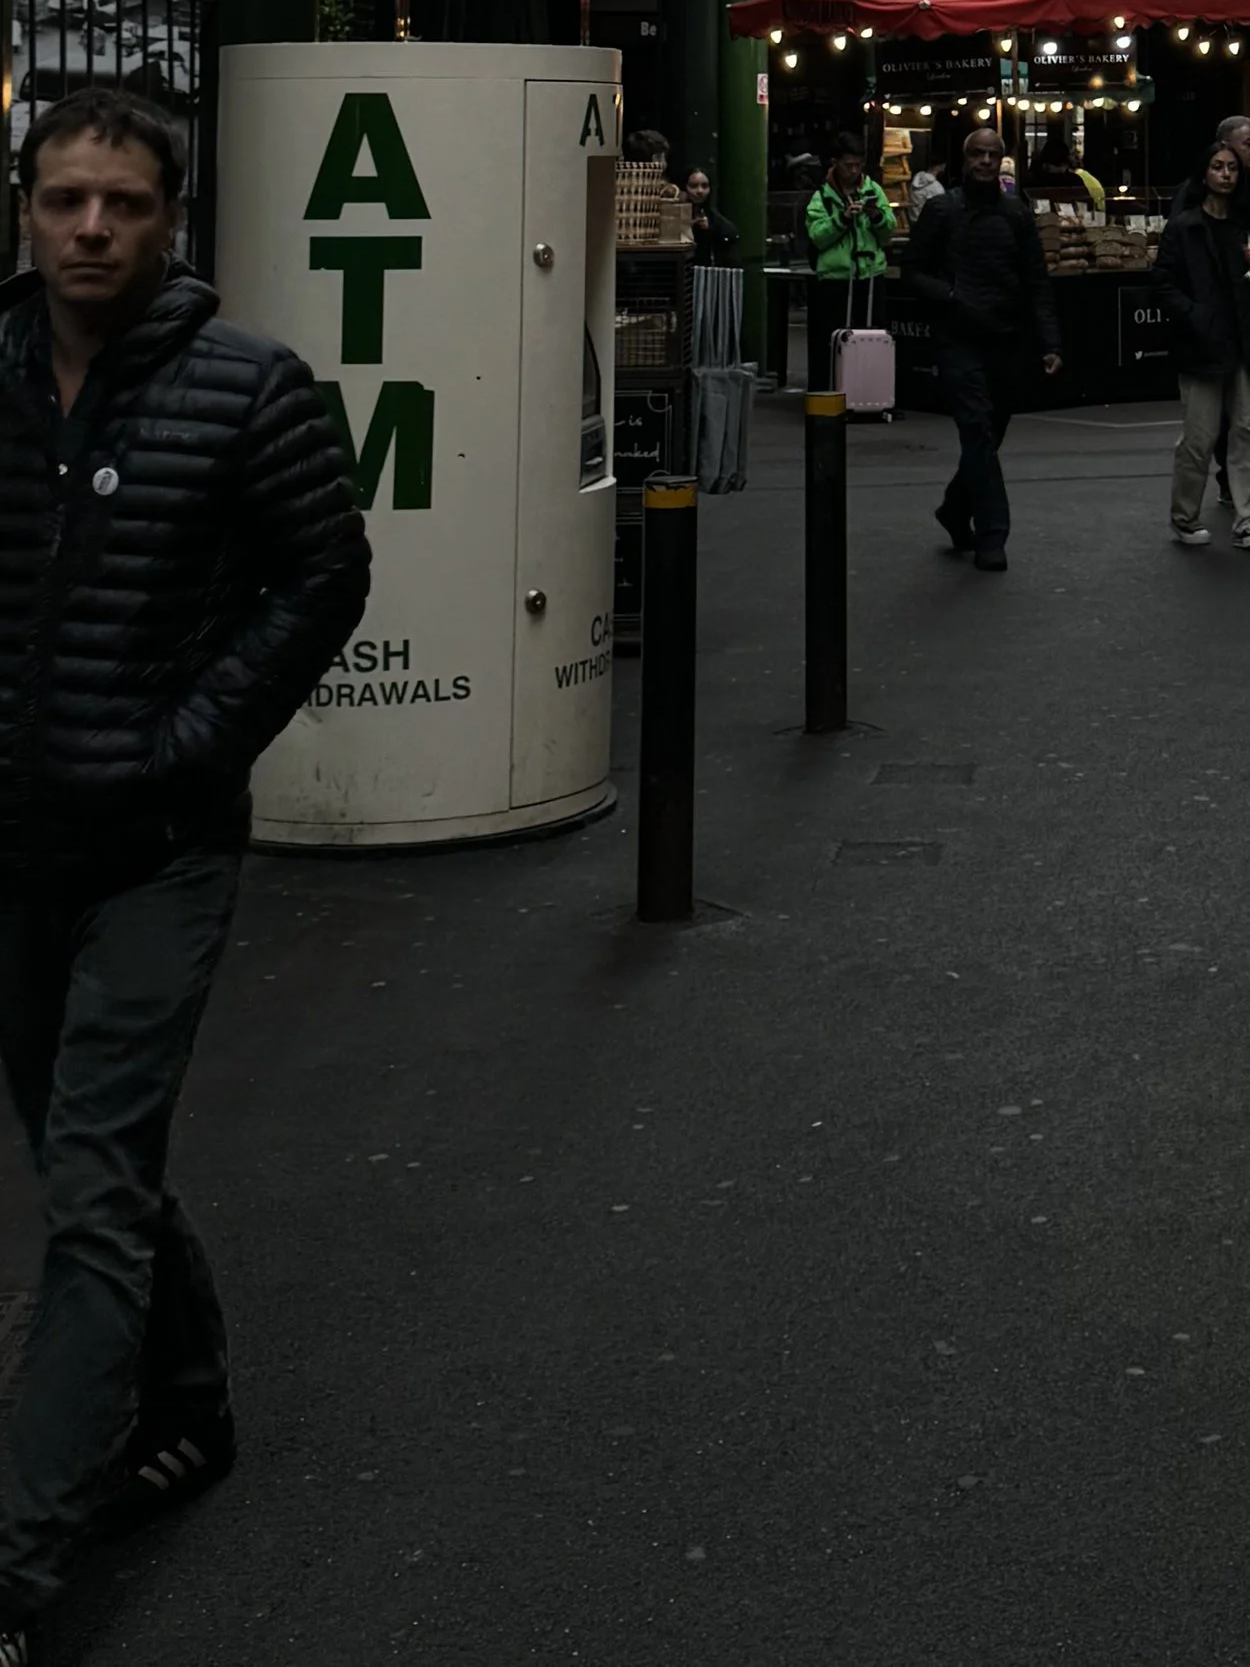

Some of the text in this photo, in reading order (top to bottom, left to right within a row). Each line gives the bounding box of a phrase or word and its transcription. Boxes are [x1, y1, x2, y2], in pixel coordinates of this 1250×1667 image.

[944, 57, 992, 71] BAKERY
[1032, 53, 1128, 65] OLIVIER'S BAKERY
[330, 639, 410, 673] ASH
[309, 675, 471, 707] DRAWALS
